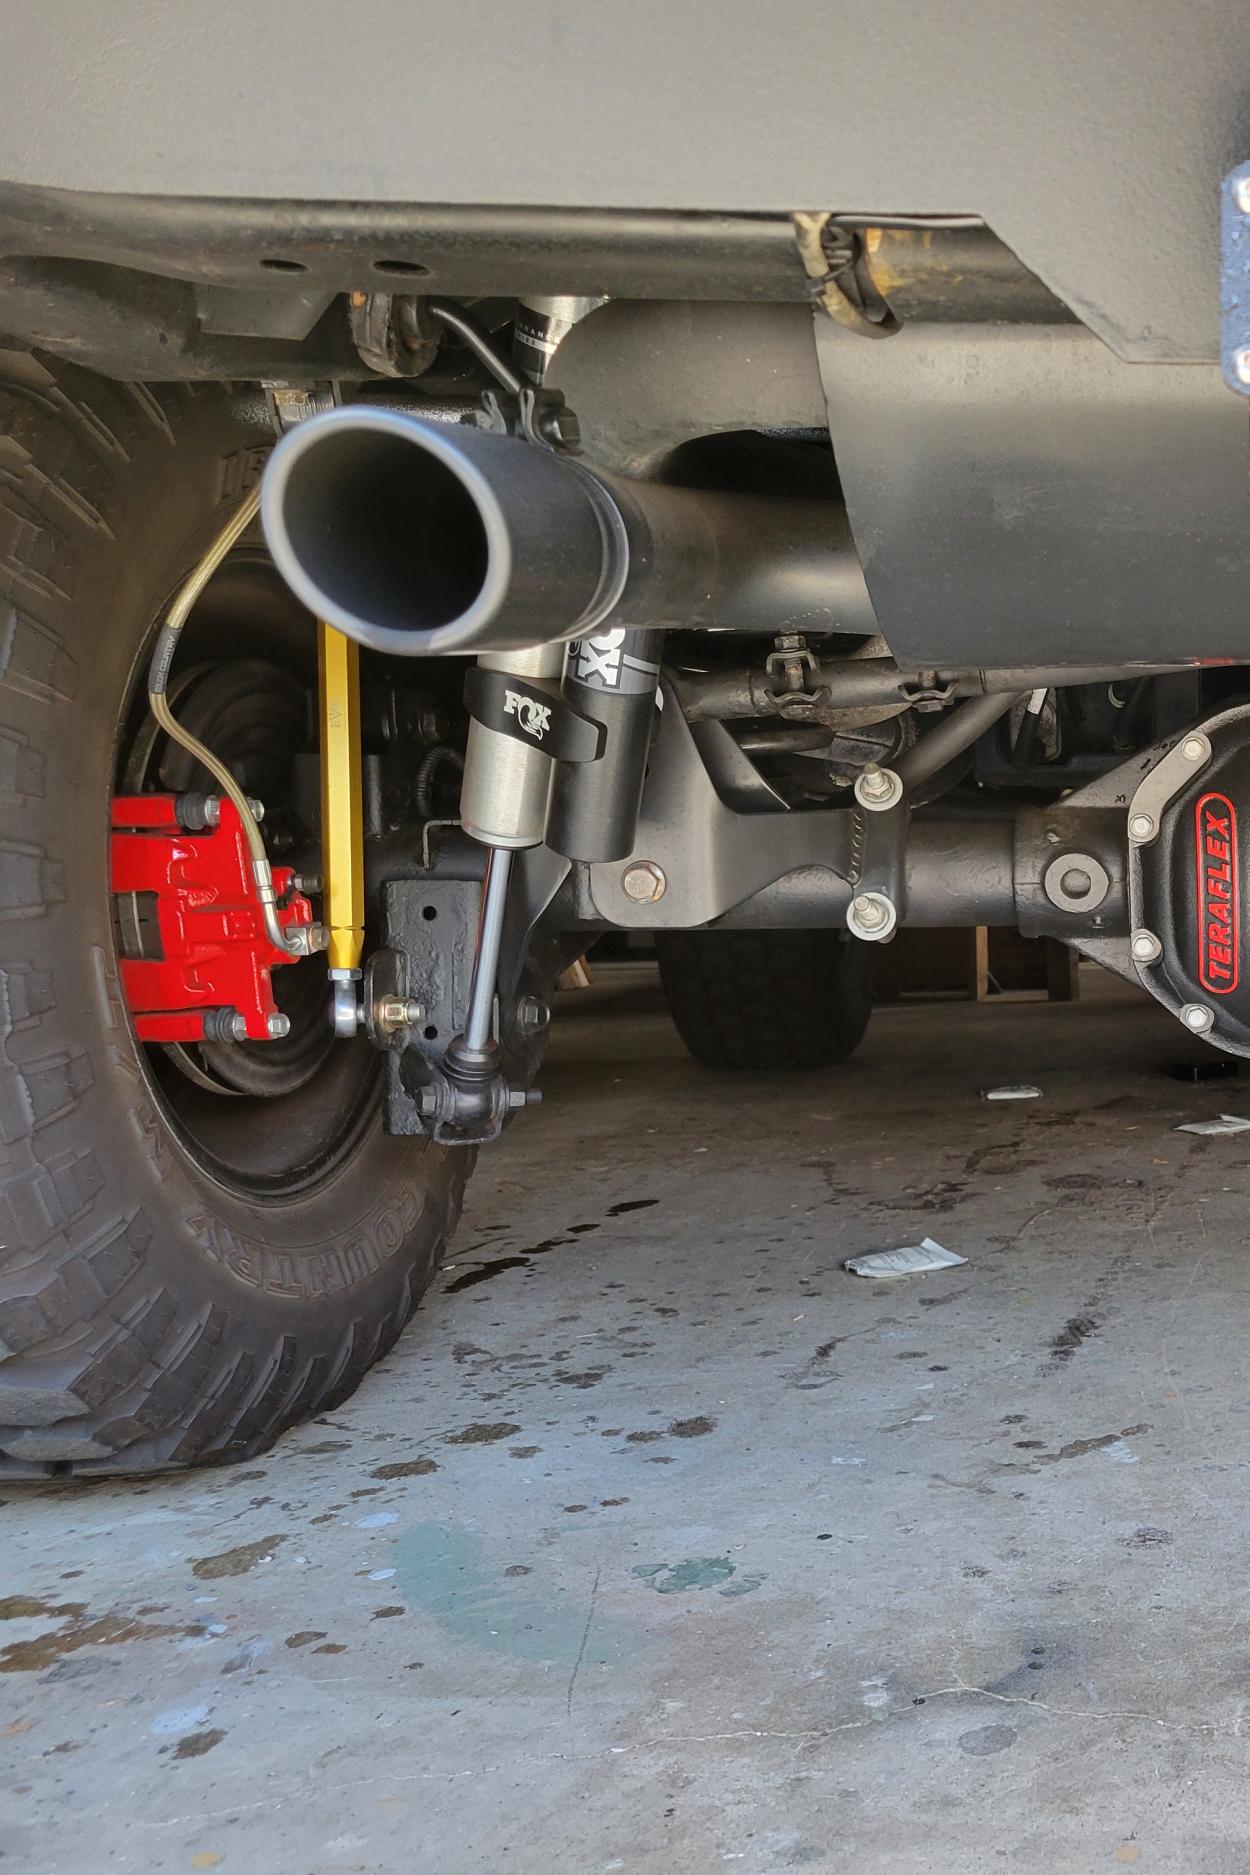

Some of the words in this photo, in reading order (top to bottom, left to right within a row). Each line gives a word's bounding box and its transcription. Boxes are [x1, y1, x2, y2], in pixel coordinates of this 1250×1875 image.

[503, 689, 552, 741] FOX
[1205, 811, 1232, 980] TERAFLEX
[184, 1174, 428, 1300] COUNTRY
